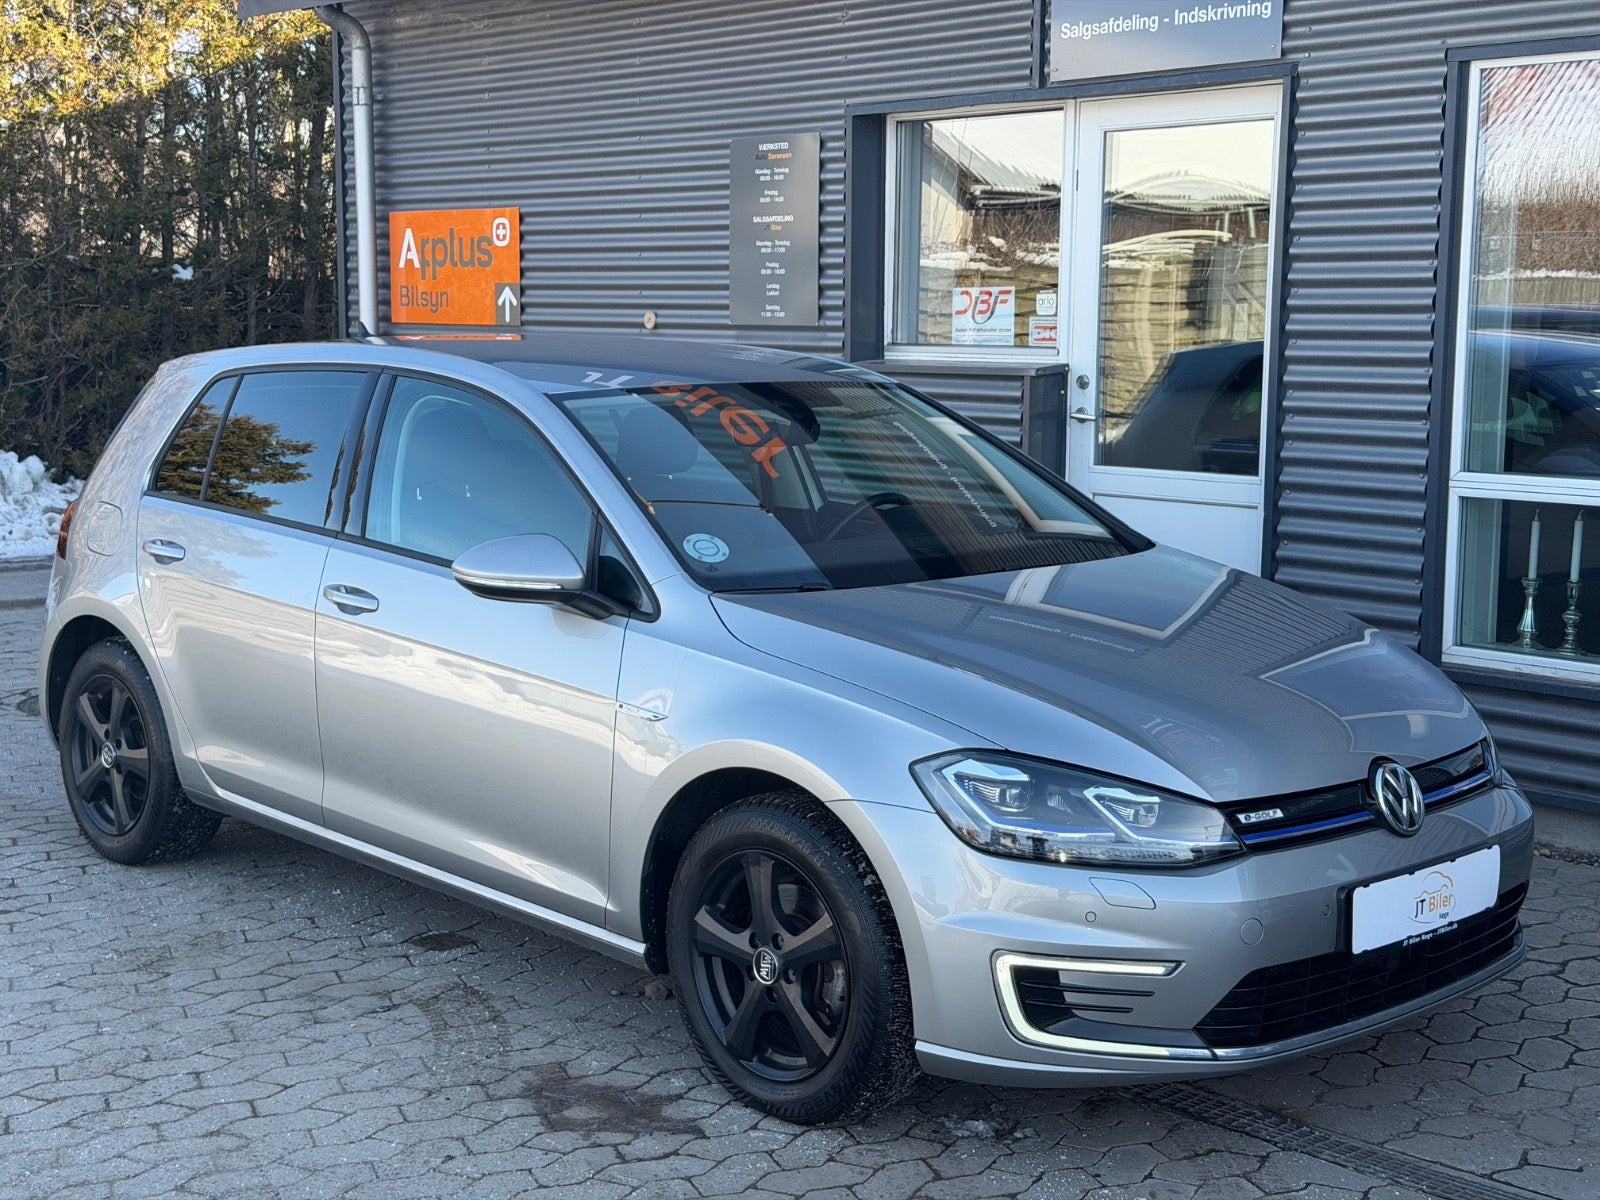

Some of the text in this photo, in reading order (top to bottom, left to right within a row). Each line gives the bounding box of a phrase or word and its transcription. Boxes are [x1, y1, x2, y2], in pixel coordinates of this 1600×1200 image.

[1060, 13, 1159, 40] Salgsafdeling
[1174, 0, 1272, 26] Indskrivning
[758, 142, 788, 151] VÆRKSTED
[753, 214, 794, 223] SALGSAFDELING
[400, 285, 449, 314] Bilsyn
[1244, 809, 1278, 821] e-GOLF
[1414, 894, 1453, 919] JT Biler
